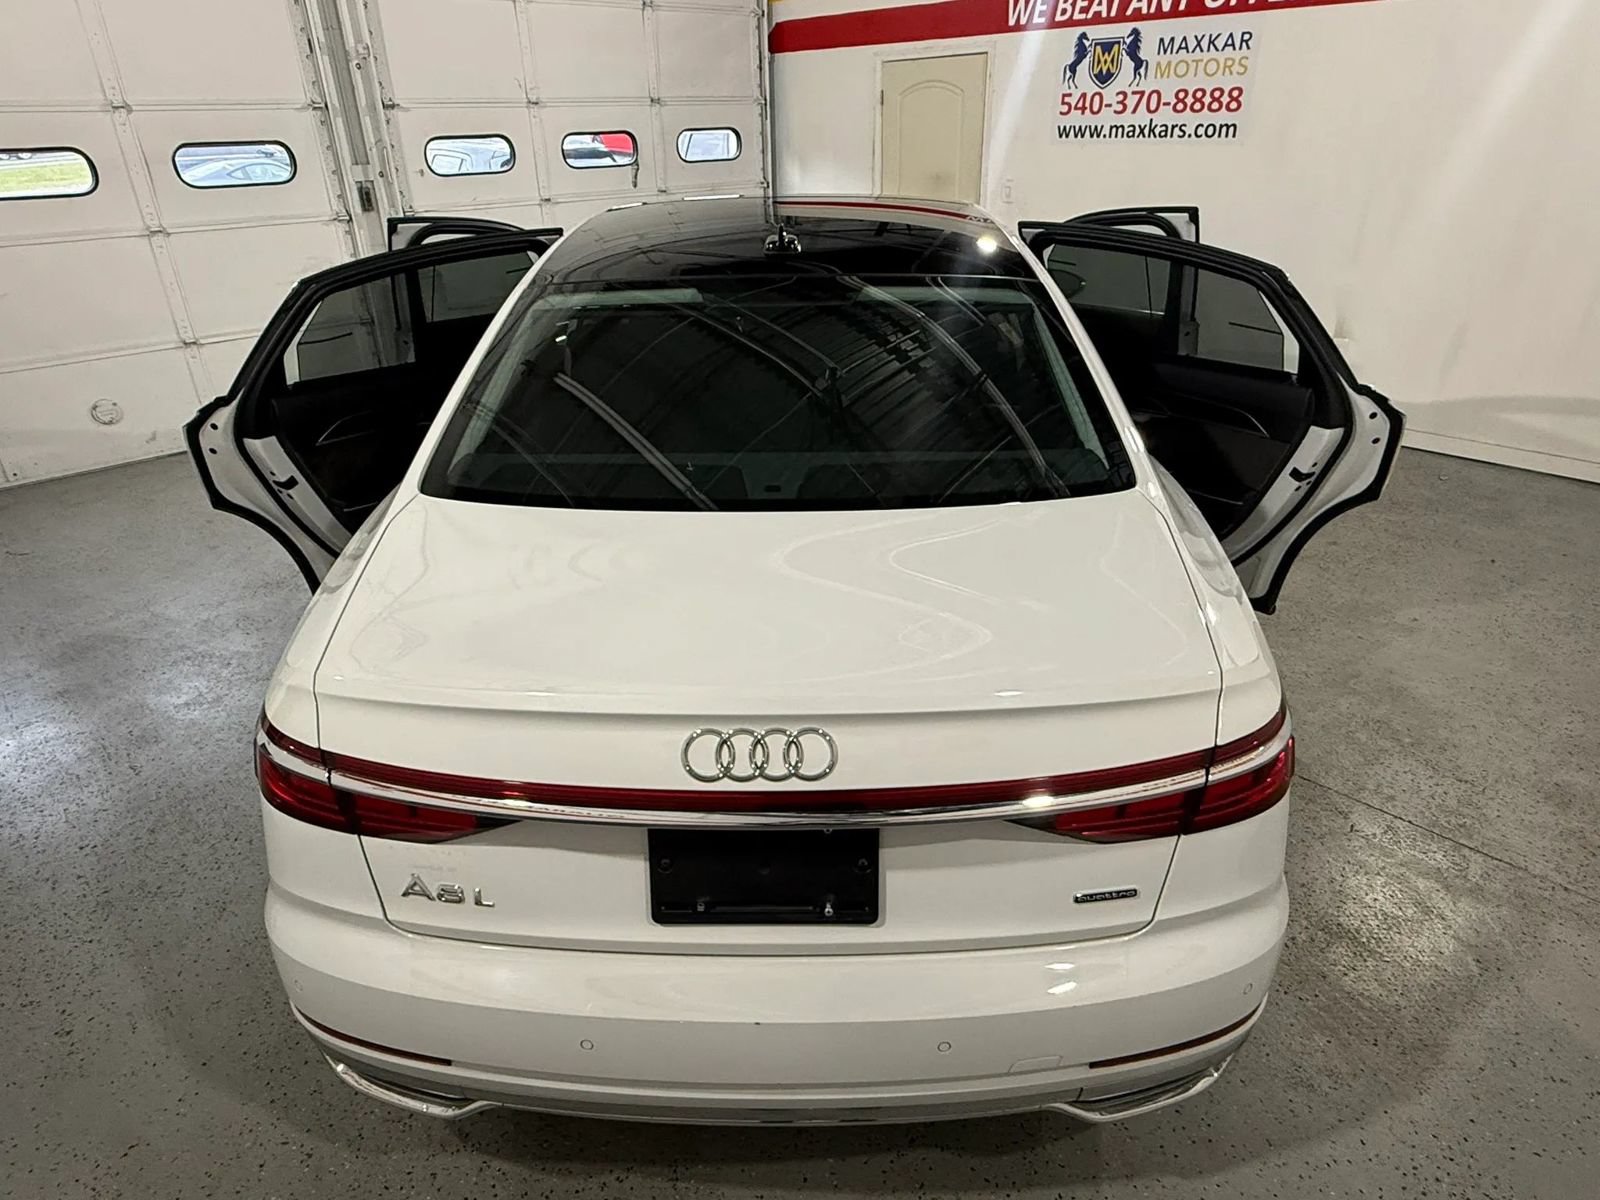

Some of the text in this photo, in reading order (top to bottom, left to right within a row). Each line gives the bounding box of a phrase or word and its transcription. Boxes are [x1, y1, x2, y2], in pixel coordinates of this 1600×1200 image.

[1007, 0, 1048, 26] WE
[1156, 31, 1253, 56] MAXKAR
[1154, 56, 1249, 79] MOTORS
[1059, 86, 1244, 116] 540-370-8888
[1057, 118, 1238, 139] www.maxkars.com
[474, 887, 495, 908] L
[1077, 890, 1136, 902] quattro
